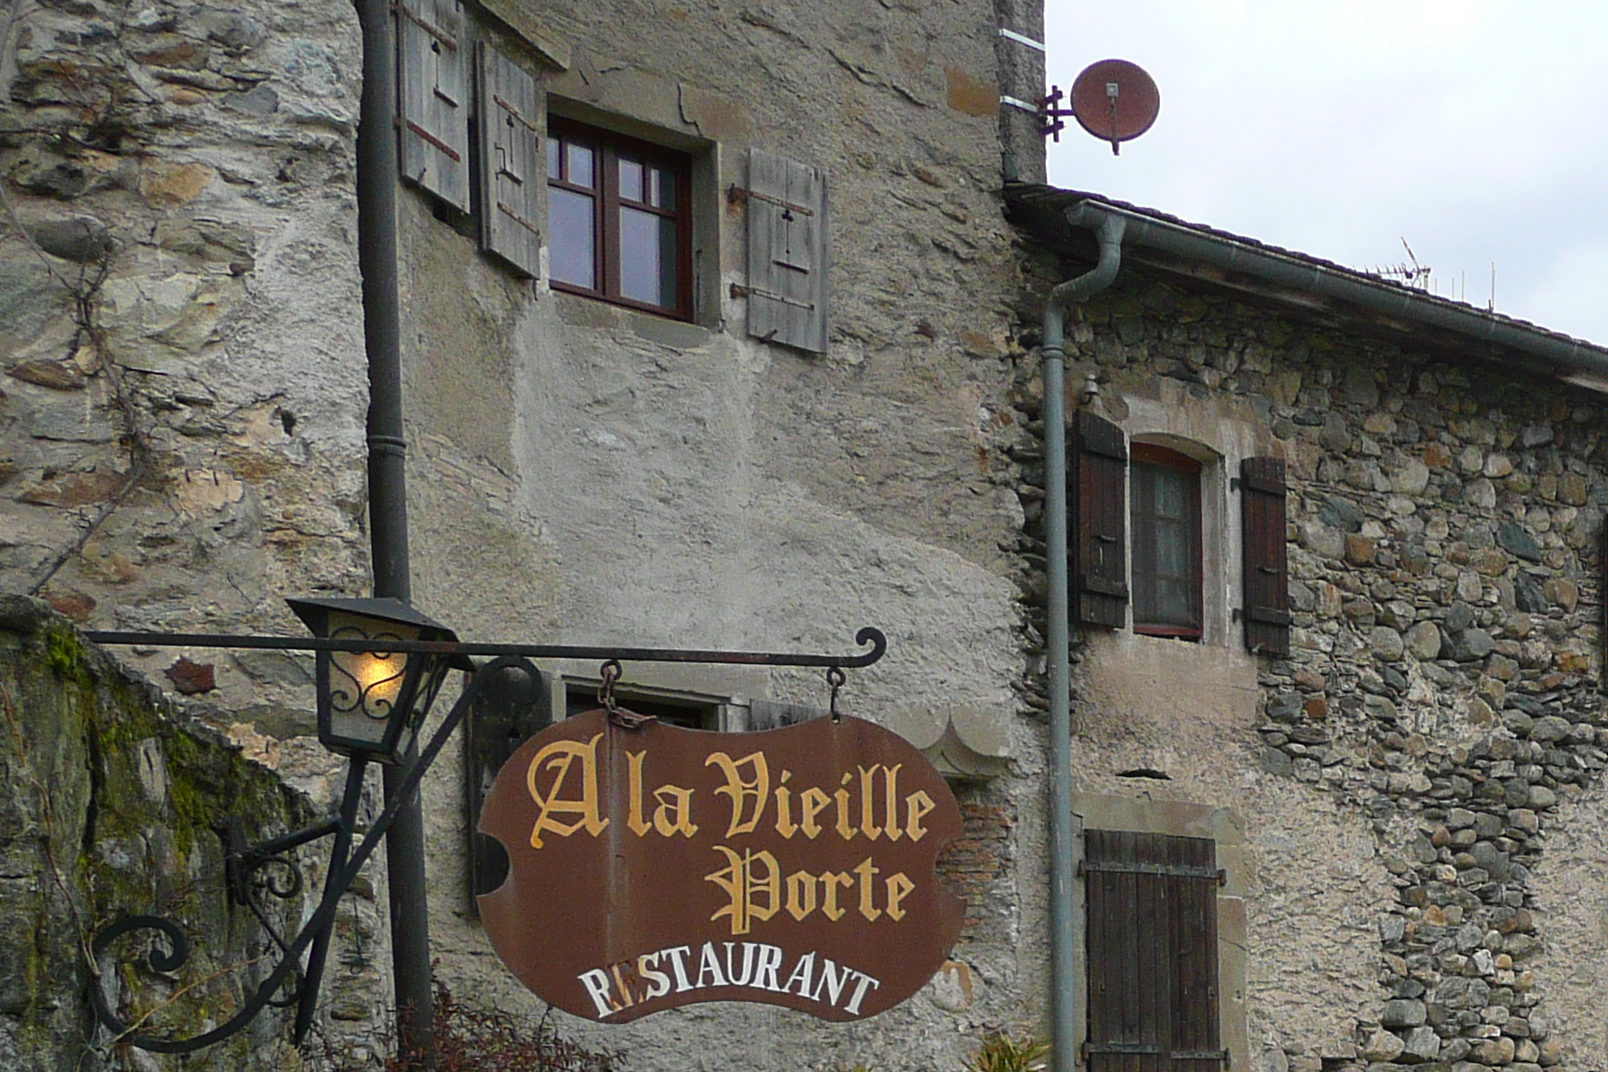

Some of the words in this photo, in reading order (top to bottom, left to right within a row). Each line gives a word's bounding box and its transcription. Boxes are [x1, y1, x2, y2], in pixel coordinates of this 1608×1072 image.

[528, 733, 610, 849] A
[625, 749, 698, 838] la
[704, 751, 936, 842] Vieille
[704, 845, 916, 936] Porte
[577, 940, 880, 1018] RESTAURANT
